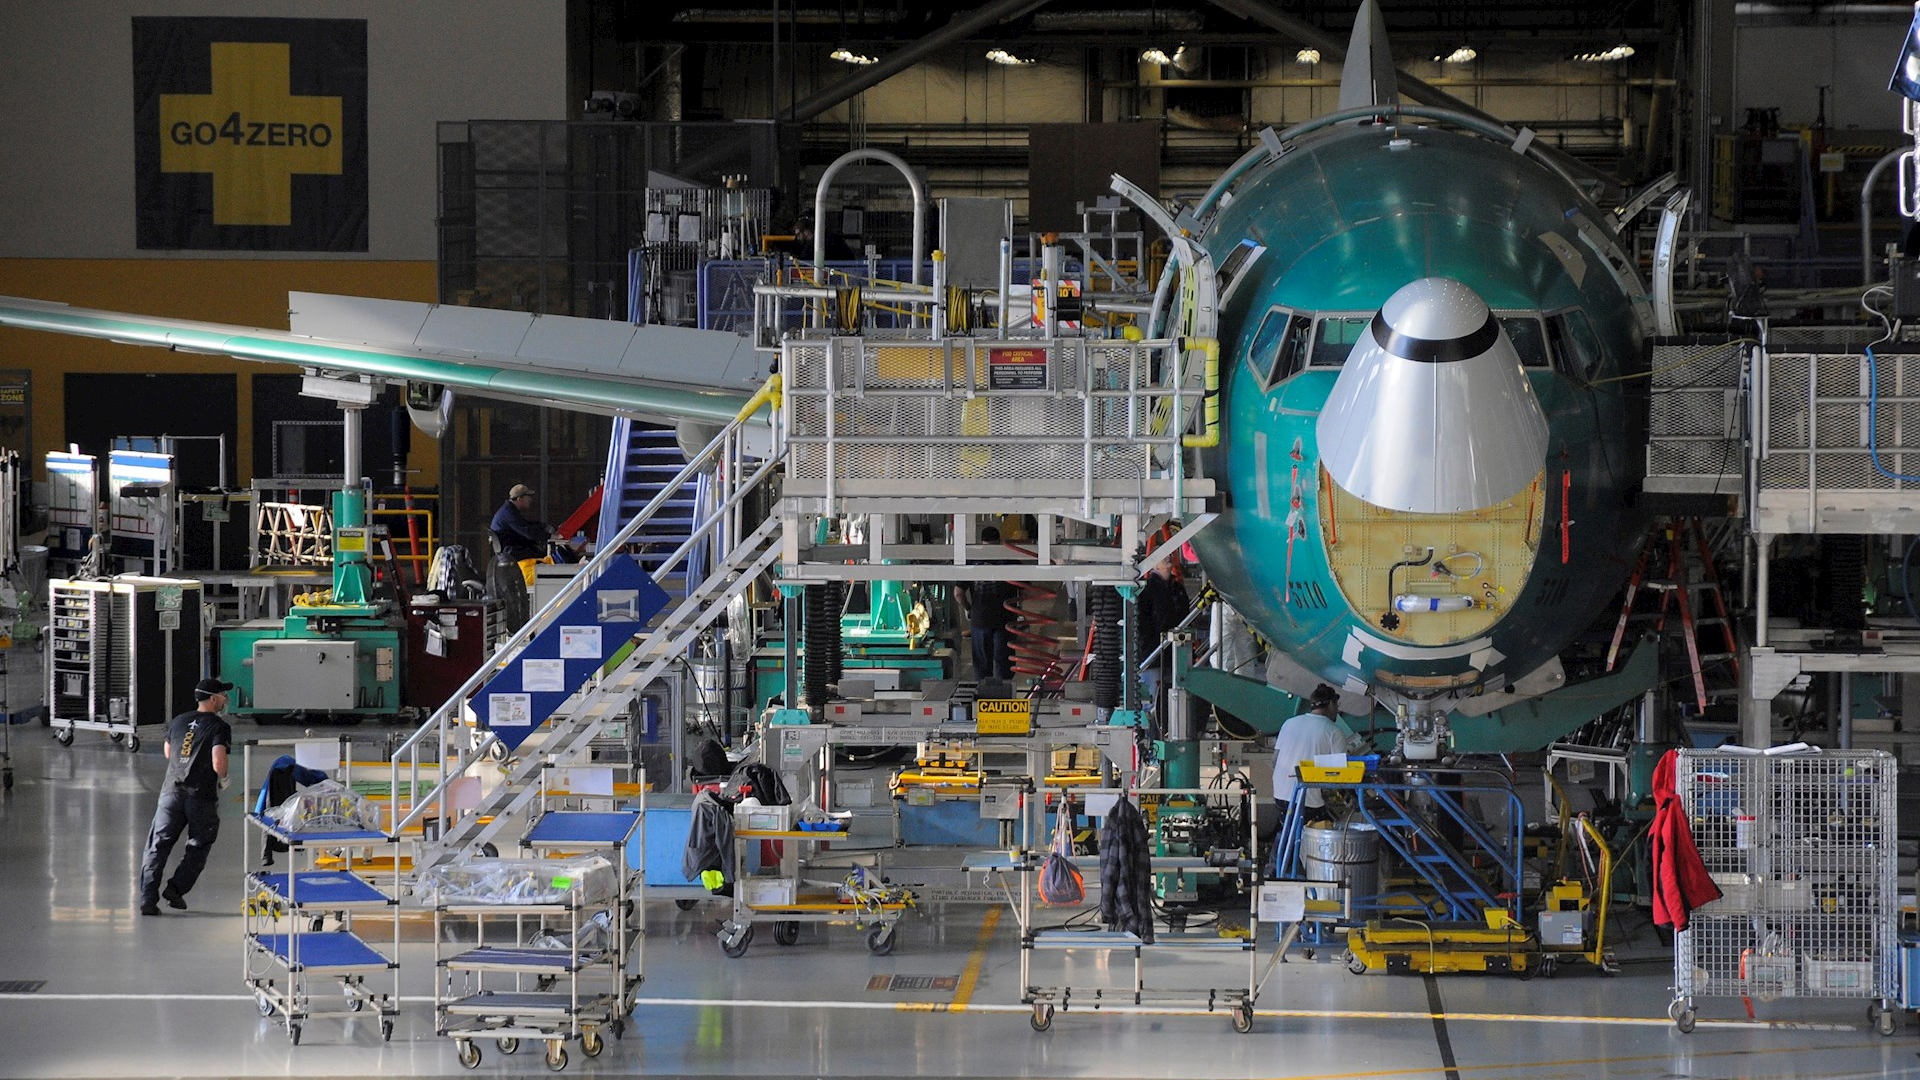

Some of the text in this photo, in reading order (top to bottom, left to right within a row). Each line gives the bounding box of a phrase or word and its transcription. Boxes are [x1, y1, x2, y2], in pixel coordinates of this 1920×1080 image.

[171, 111, 332, 147] GO4ZERO
[686, 293, 695, 304] 15
[980, 702, 1027, 712] CAUTION
[1140, 794, 1160, 804] CAU
